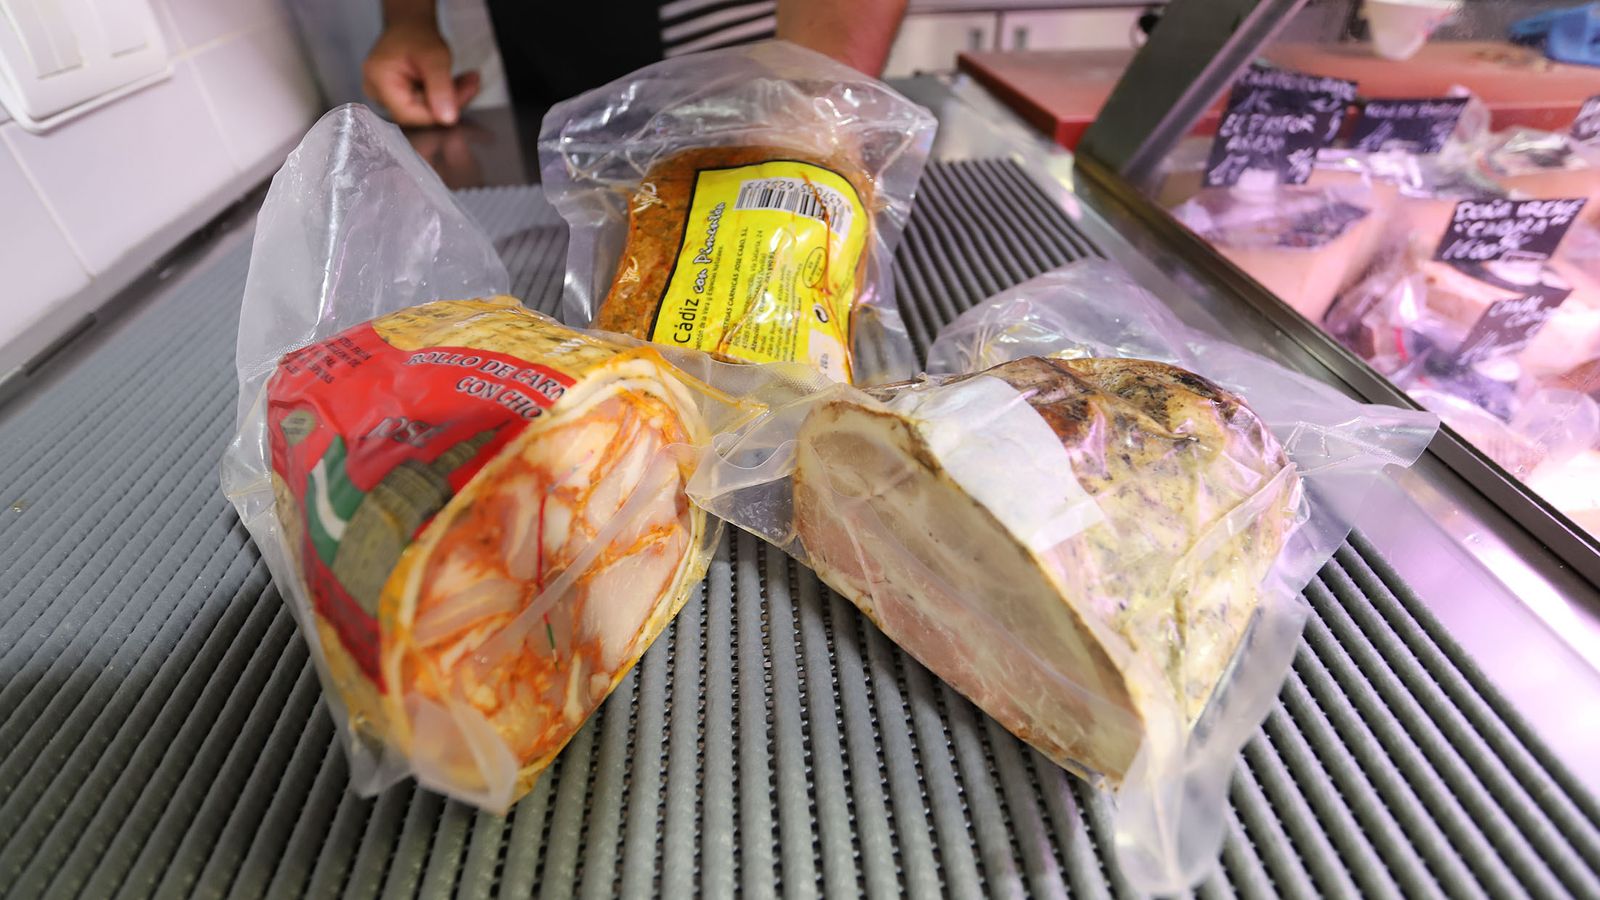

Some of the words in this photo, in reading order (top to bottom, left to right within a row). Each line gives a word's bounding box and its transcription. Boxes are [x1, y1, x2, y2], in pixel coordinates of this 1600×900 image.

[693, 201, 726, 265] Pimentón
[693, 268, 708, 294] con
[673, 298, 700, 344] Cádiz
[404, 351, 482, 368] ROLLO
[476, 359, 518, 379] DE
[455, 375, 505, 400] CON
[496, 389, 545, 420] CHO
